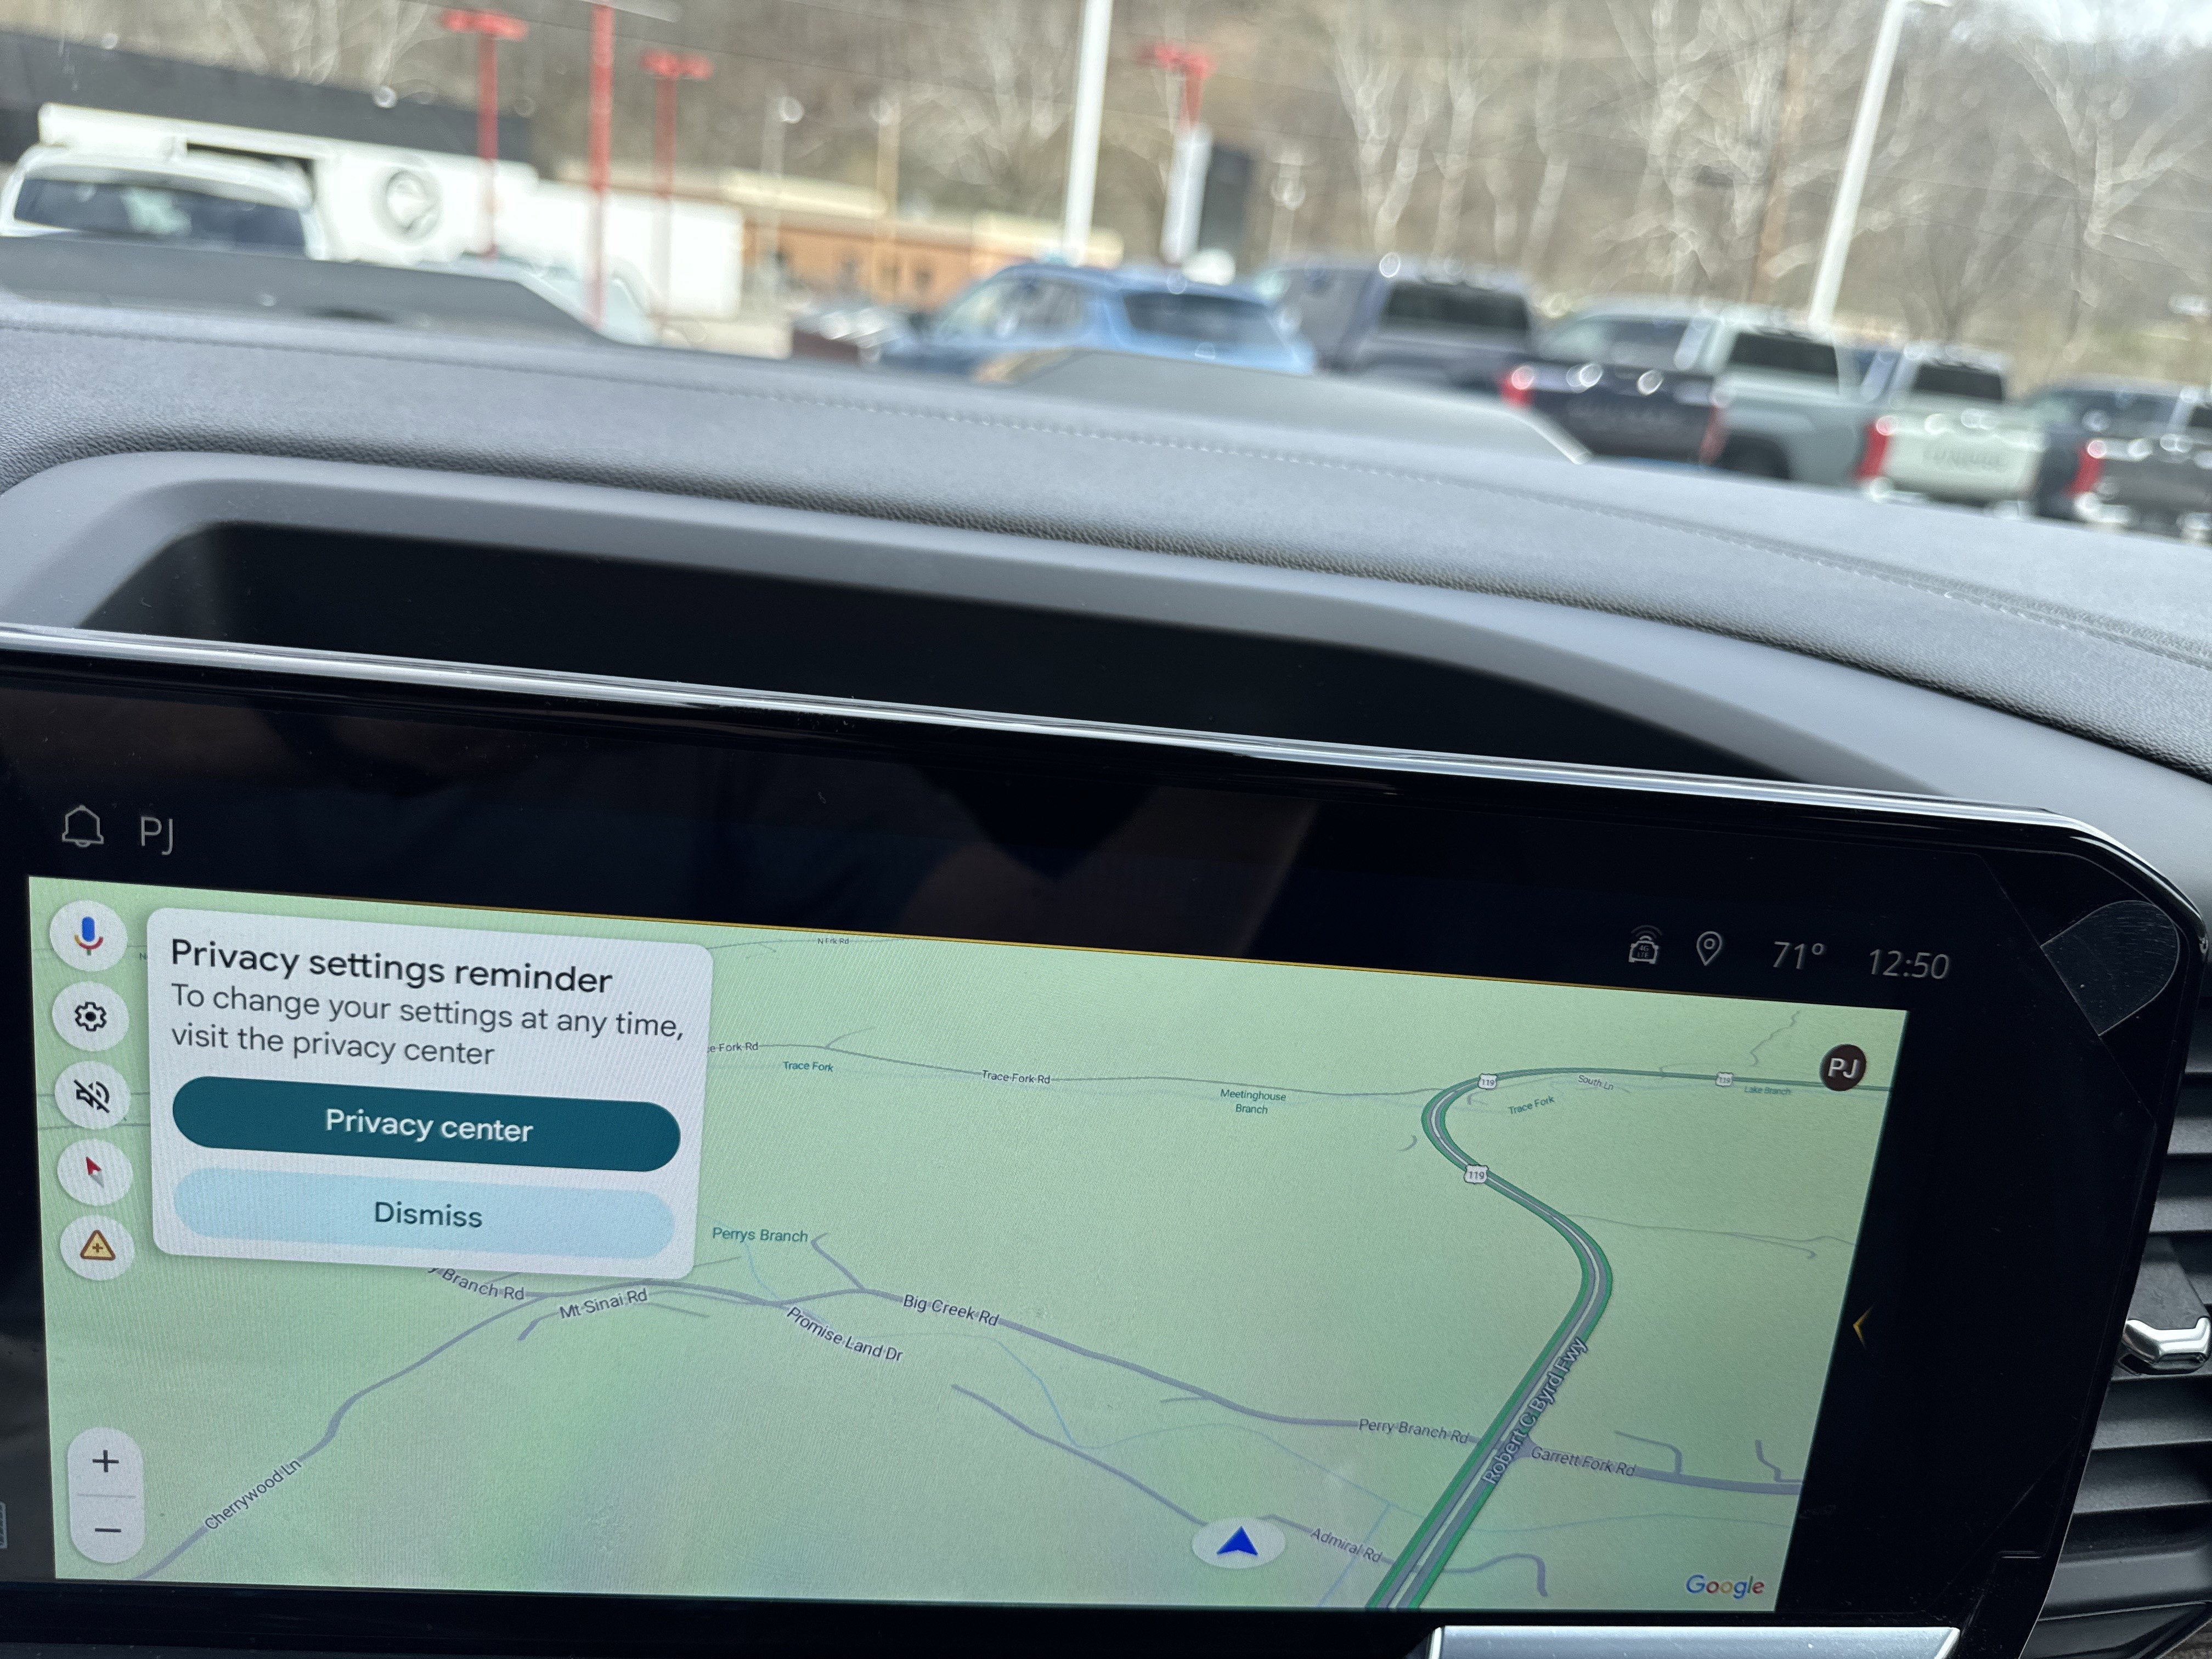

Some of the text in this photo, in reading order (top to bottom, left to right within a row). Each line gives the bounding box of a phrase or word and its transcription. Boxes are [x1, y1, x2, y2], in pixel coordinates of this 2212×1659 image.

[139, 815, 176, 855] PJ
[172, 938, 613, 993] Privacy settings reminder
[1772, 940, 1826, 970] 71°
[1869, 948, 1951, 980] 12:50
[172, 984, 683, 1040] To change your settings at any time,
[172, 1023, 495, 1065] visit the privacy center
[719, 1042, 743, 1052] Fork
[745, 1041, 759, 1051] Rd
[783, 1061, 833, 1072] Trace Fork
[982, 1069, 1051, 1084] Trace Fork Rd
[1828, 1057, 1860, 1080] PJ
[1220, 1088, 1286, 1102] Meetinghouse
[1578, 1074, 1614, 1091] South Ln
[1235, 1103, 1268, 1114] Branch
[1508, 1095, 1555, 1115] Trace Fork
[326, 1108, 534, 1143] Privacy center
[1469, 1171, 1485, 1180] 119
[374, 1201, 483, 1229] Dismiss
[712, 1227, 809, 1244] Perrys Branch
[441, 1268, 524, 1300] Branch Rd
[560, 1288, 648, 1319] Mt Sinai Rd
[902, 1294, 1000, 1327] Big Creek Rd
[787, 1305, 904, 1362] Promise Land Dr
[1481, 1335, 1589, 1485] Robert C Byrd Fwy
[1358, 1418, 1470, 1444] Perry Branch Rd
[1531, 1444, 1635, 1477] Garrett Fork Rd
[204, 1458, 302, 1530] Cherrywood Ln
[1310, 1527, 1383, 1564] Admiral Rd
[1685, 1573, 1765, 1599] Google
